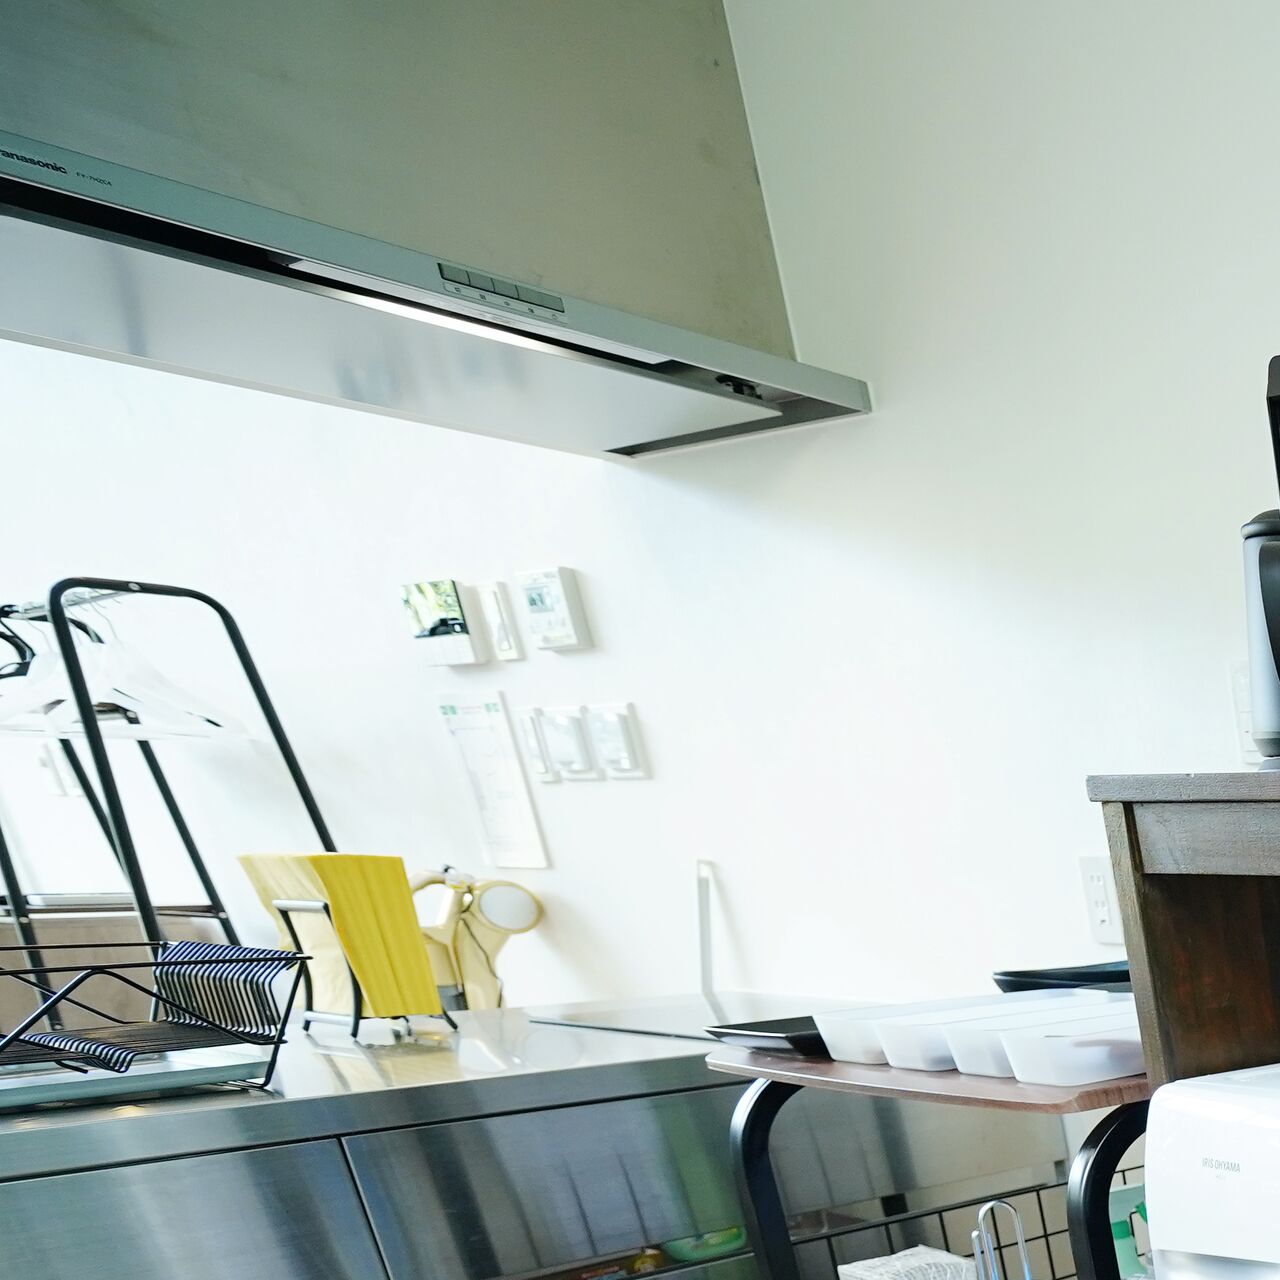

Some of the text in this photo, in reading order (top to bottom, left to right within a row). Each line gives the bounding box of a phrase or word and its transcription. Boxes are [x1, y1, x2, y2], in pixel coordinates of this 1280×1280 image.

[0, 149, 68, 175] anasonic
[1201, 1157, 1241, 1173] IRIS OHYAMA
